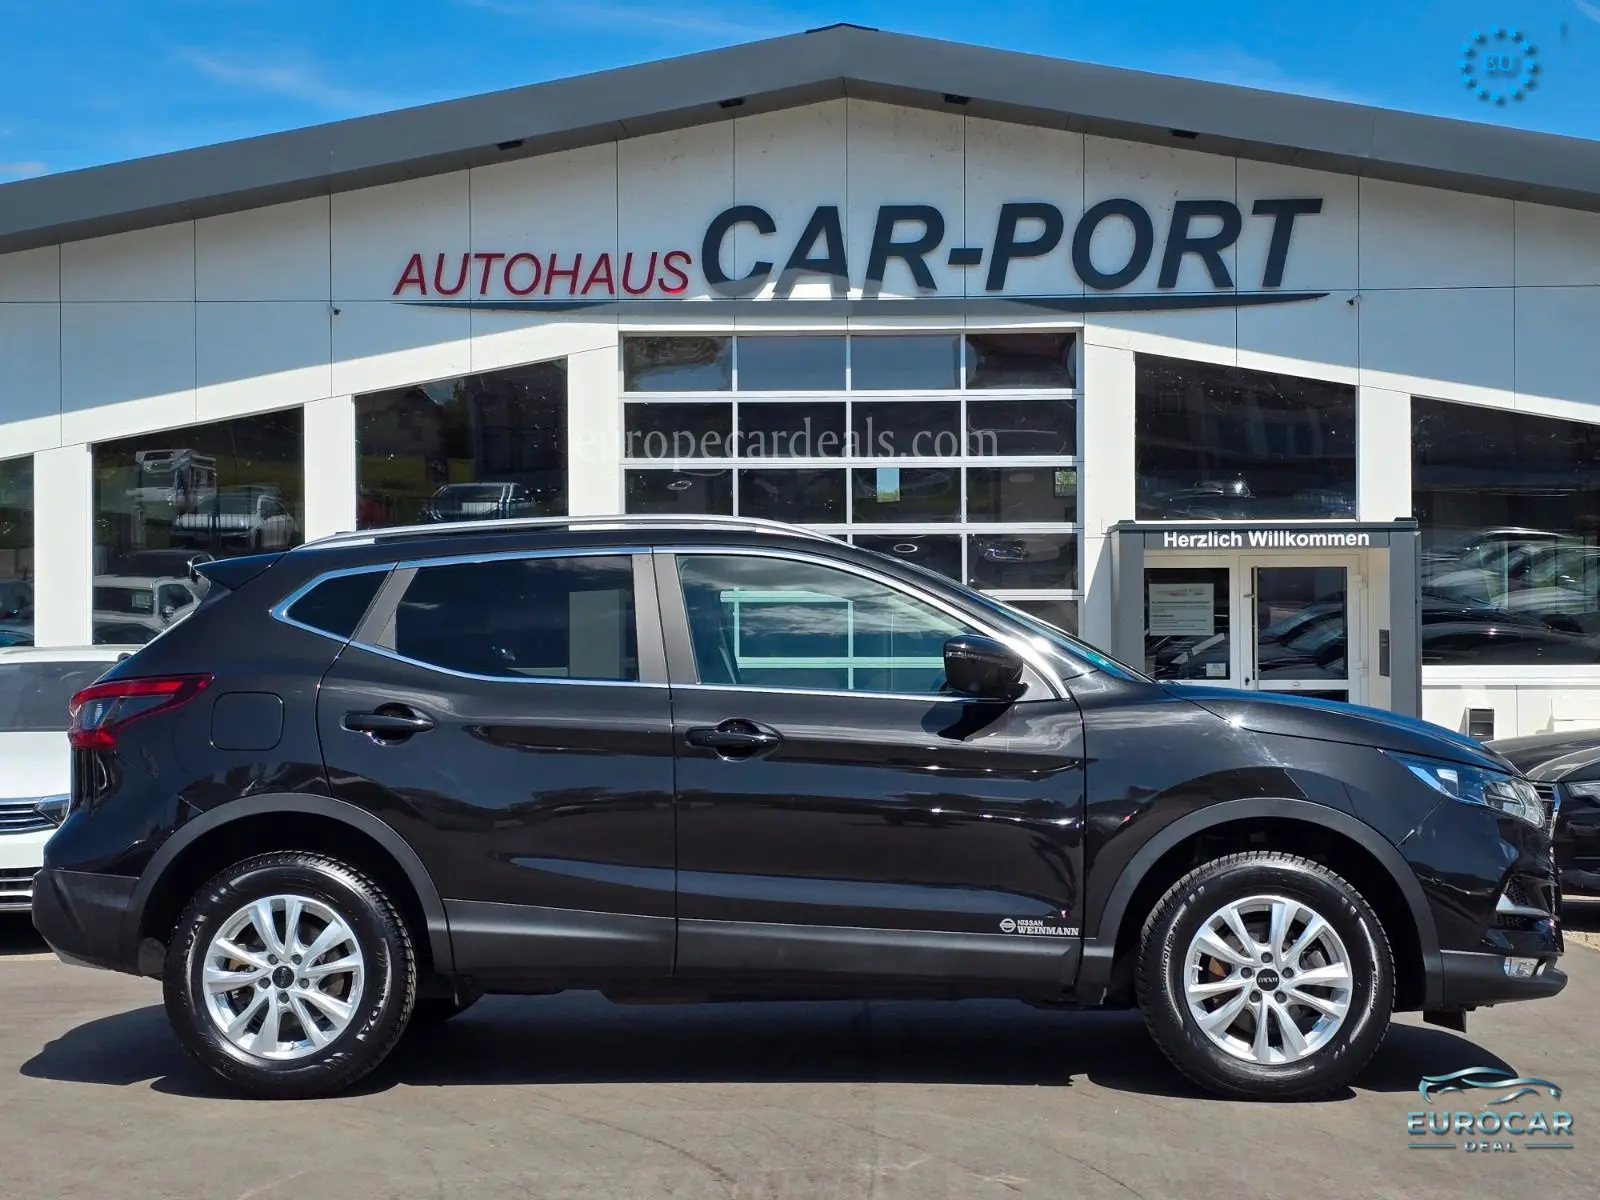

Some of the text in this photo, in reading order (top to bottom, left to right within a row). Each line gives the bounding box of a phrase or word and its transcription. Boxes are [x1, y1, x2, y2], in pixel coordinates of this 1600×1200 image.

[394, 198, 1324, 302] AUTOHAUS CAR-PORT
[1163, 529, 1370, 548] Herzlich Willkommen
[1017, 919, 1043, 927] NISSAN
[1017, 926, 1080, 936] WEINMANN
